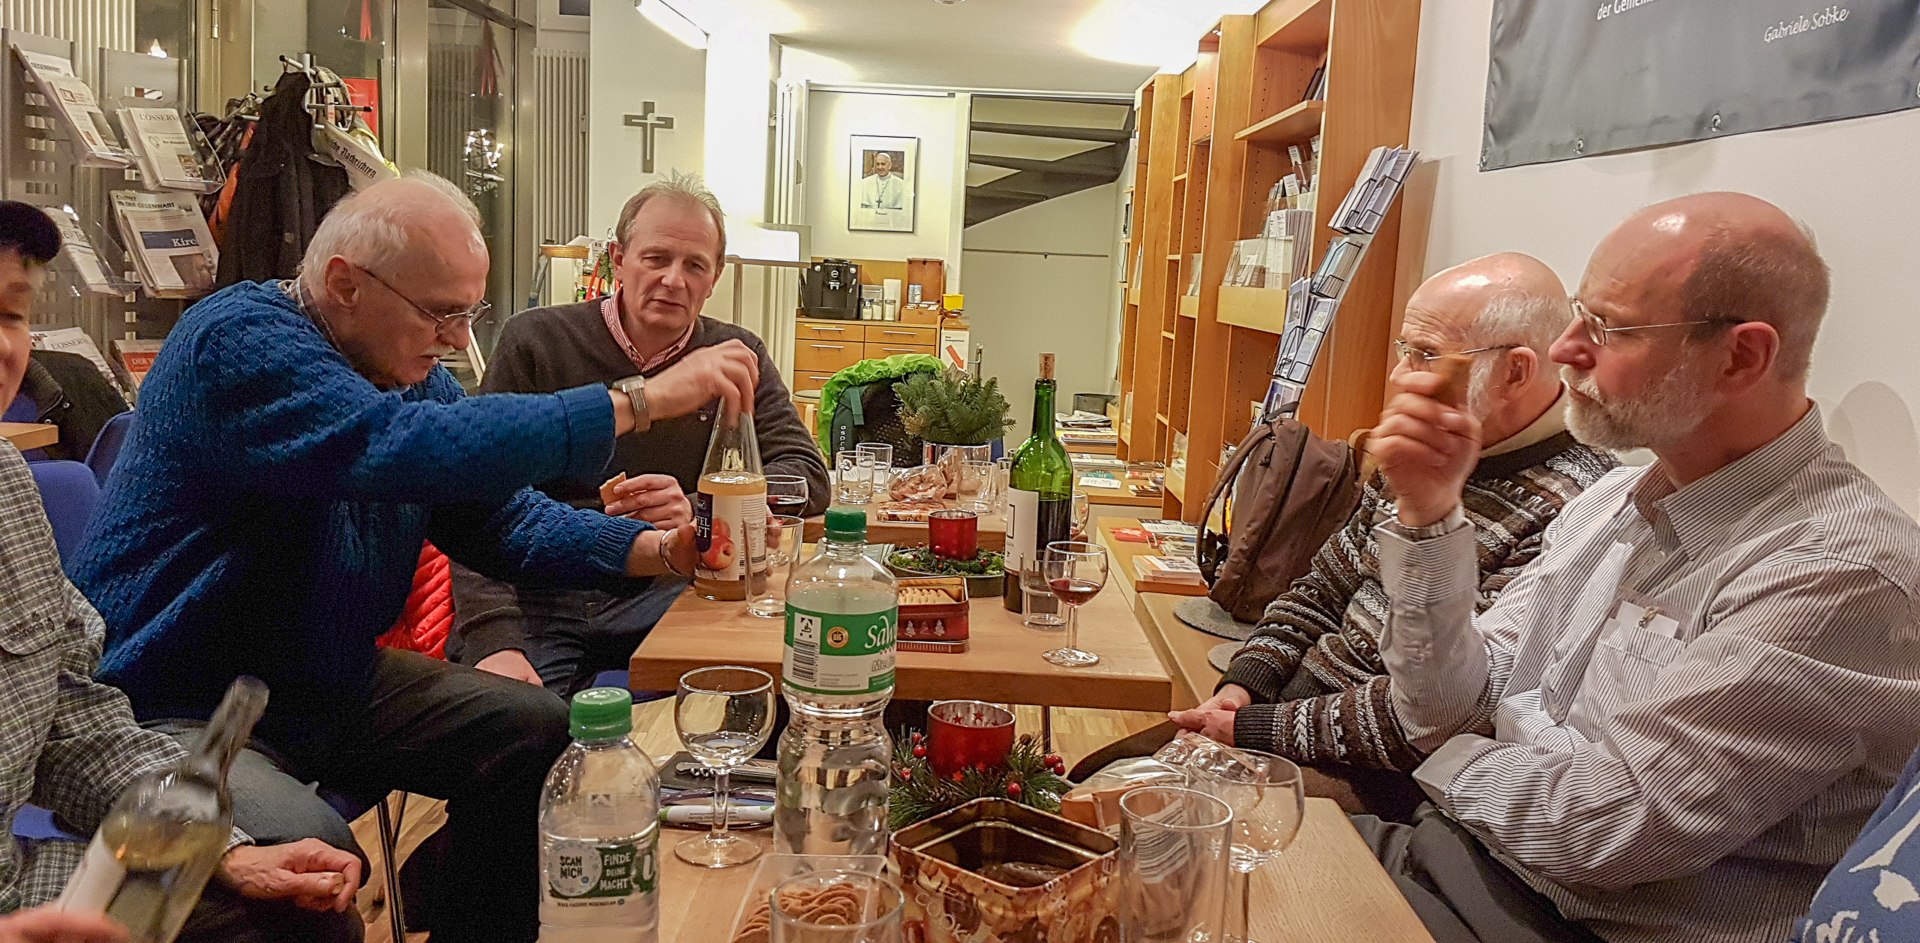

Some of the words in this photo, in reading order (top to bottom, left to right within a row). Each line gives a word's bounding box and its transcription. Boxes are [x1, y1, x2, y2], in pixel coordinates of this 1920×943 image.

[1597, 3, 1612, 21] der
[1764, 15, 1810, 43] Gabriele
[1811, 5, 1850, 30] Sobke
[560, 855, 582, 867] SCAN
[603, 852, 631, 866] FINDE
[560, 866, 583, 879] MICH
[600, 877, 628, 890] MACHT
